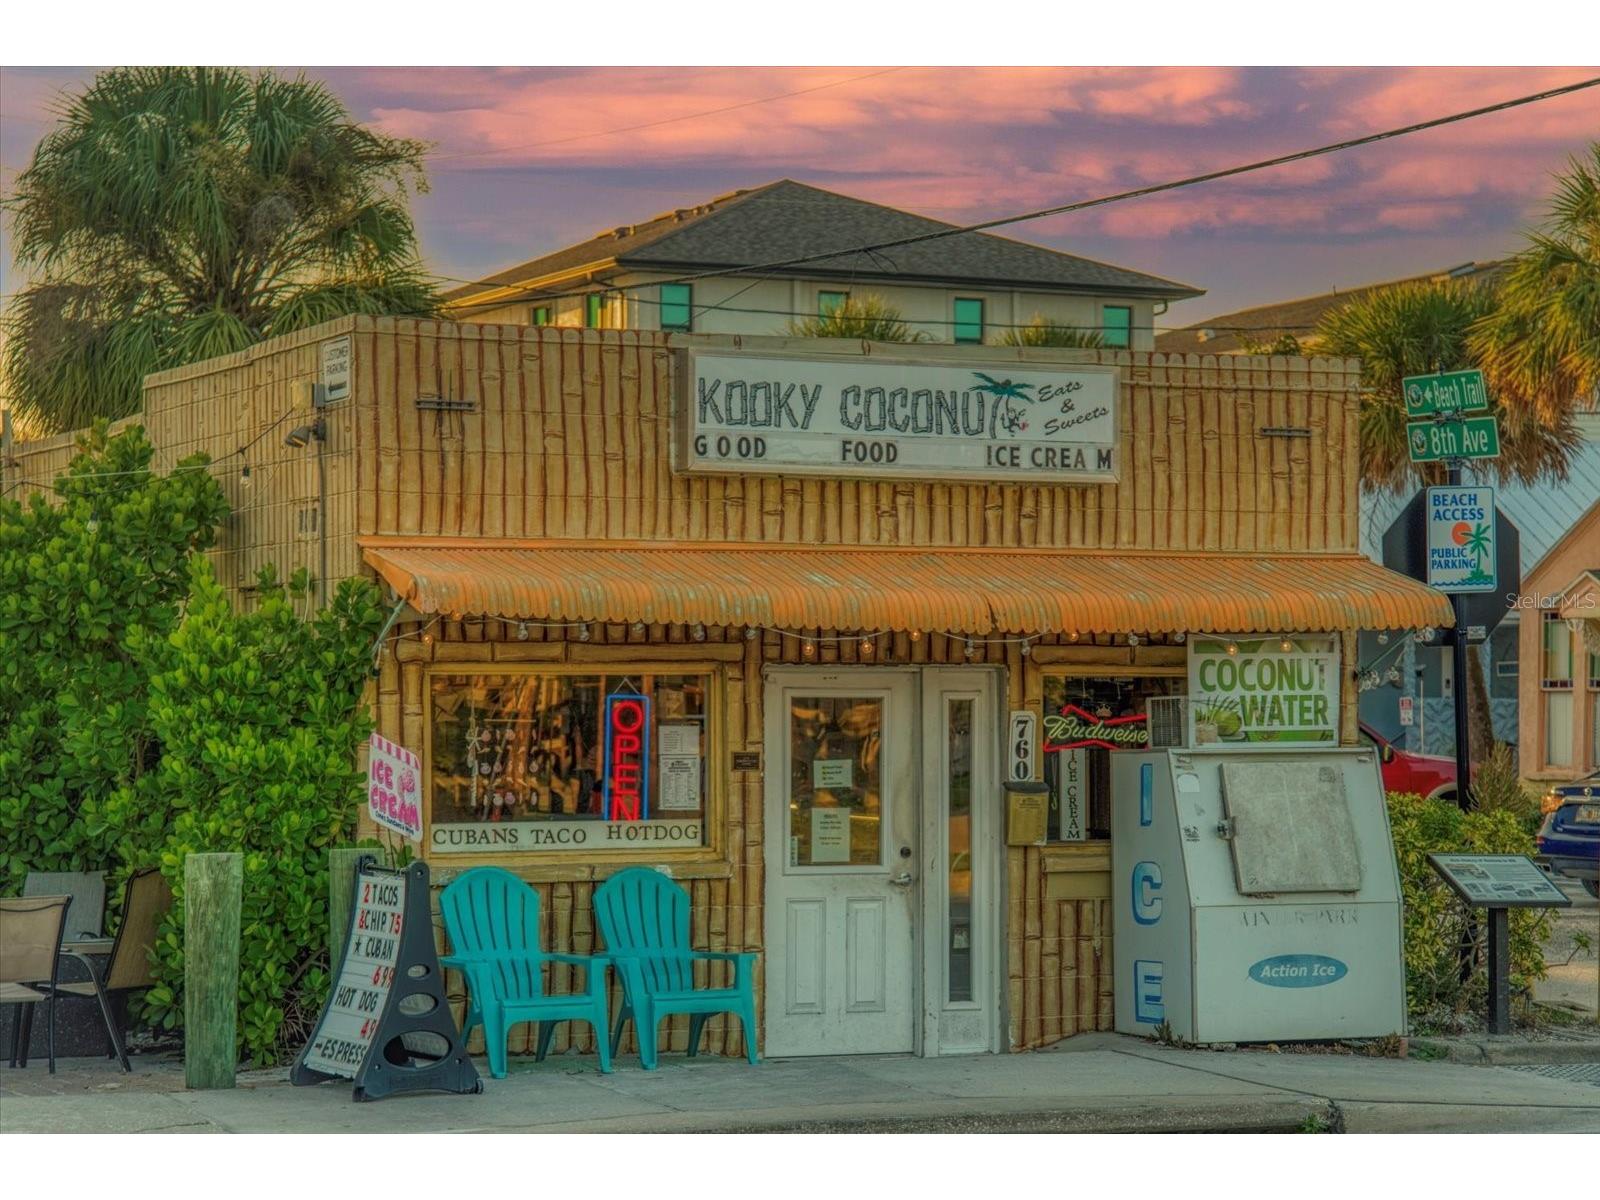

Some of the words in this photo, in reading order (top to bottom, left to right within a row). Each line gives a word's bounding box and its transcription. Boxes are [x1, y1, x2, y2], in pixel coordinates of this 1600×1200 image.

[698, 378, 823, 430] KOOKY
[1038, 381, 1084, 402] Eats
[1433, 379, 1460, 407] Beach
[1462, 375, 1484, 404] Trail
[1060, 398, 1076, 414] &
[1044, 407, 1109, 436] Sweets
[694, 434, 766, 458] GOOD
[841, 440, 898, 463] FOOD
[986, 445, 1020, 467] ICE
[1431, 426, 1455, 455] 8th
[1462, 426, 1488, 452] Ave
[1432, 494, 1478, 506] BEACH
[1432, 508, 1485, 521] ACCESS
[1431, 548, 1468, 558] PUBLIC
[1431, 558, 1477, 570] PARKING
[1200, 658, 1326, 692] COCONUT
[1240, 695, 1328, 727] WATER
[1044, 715, 1149, 742] Budweise
[611, 701, 643, 821] OPEN
[1014, 719, 1029, 780] 760
[371, 758, 393, 791] ICE
[1067, 749, 1078, 782] ICE
[370, 783, 420, 831] CREAM
[1066, 785, 1081, 839] CREAM
[432, 828, 518, 846] CUBANS
[530, 828, 587, 844] TACO
[606, 824, 699, 841] HOTDOG
[363, 883, 370, 903] 2
[371, 884, 398, 906] TACOS
[1130, 763, 1165, 1024] ICE
[365, 936, 394, 960] CUBAN
[1260, 964, 1307, 978] Action
[1311, 964, 1337, 976] Ice
[335, 985, 357, 1008] HOT
[358, 991, 379, 1013] DOG
